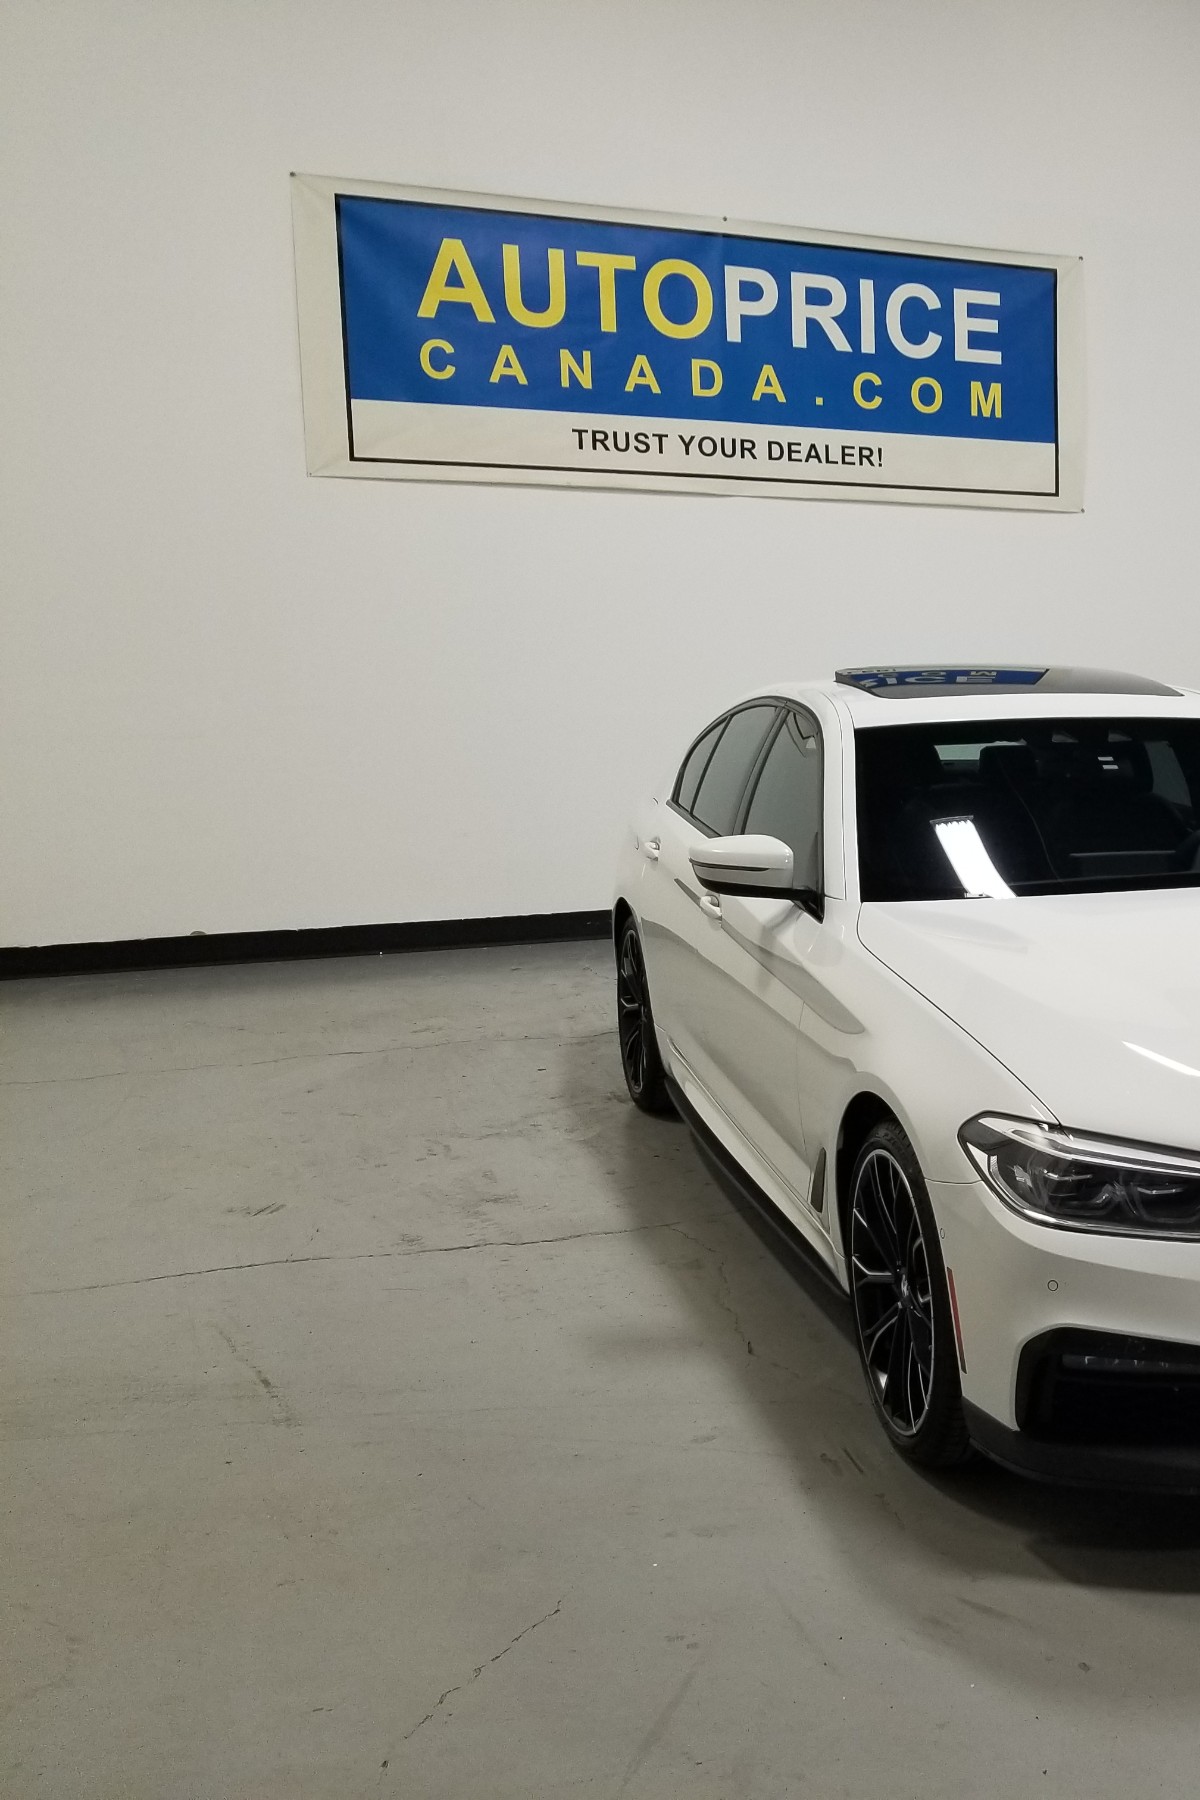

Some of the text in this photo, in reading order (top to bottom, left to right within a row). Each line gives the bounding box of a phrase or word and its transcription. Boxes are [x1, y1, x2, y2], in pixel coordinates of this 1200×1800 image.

[417, 237, 1002, 365] AUTOPRICE
[419, 338, 1002, 418] CANADA.COM
[571, 428, 884, 467] TRUST YOUR DEALER!
